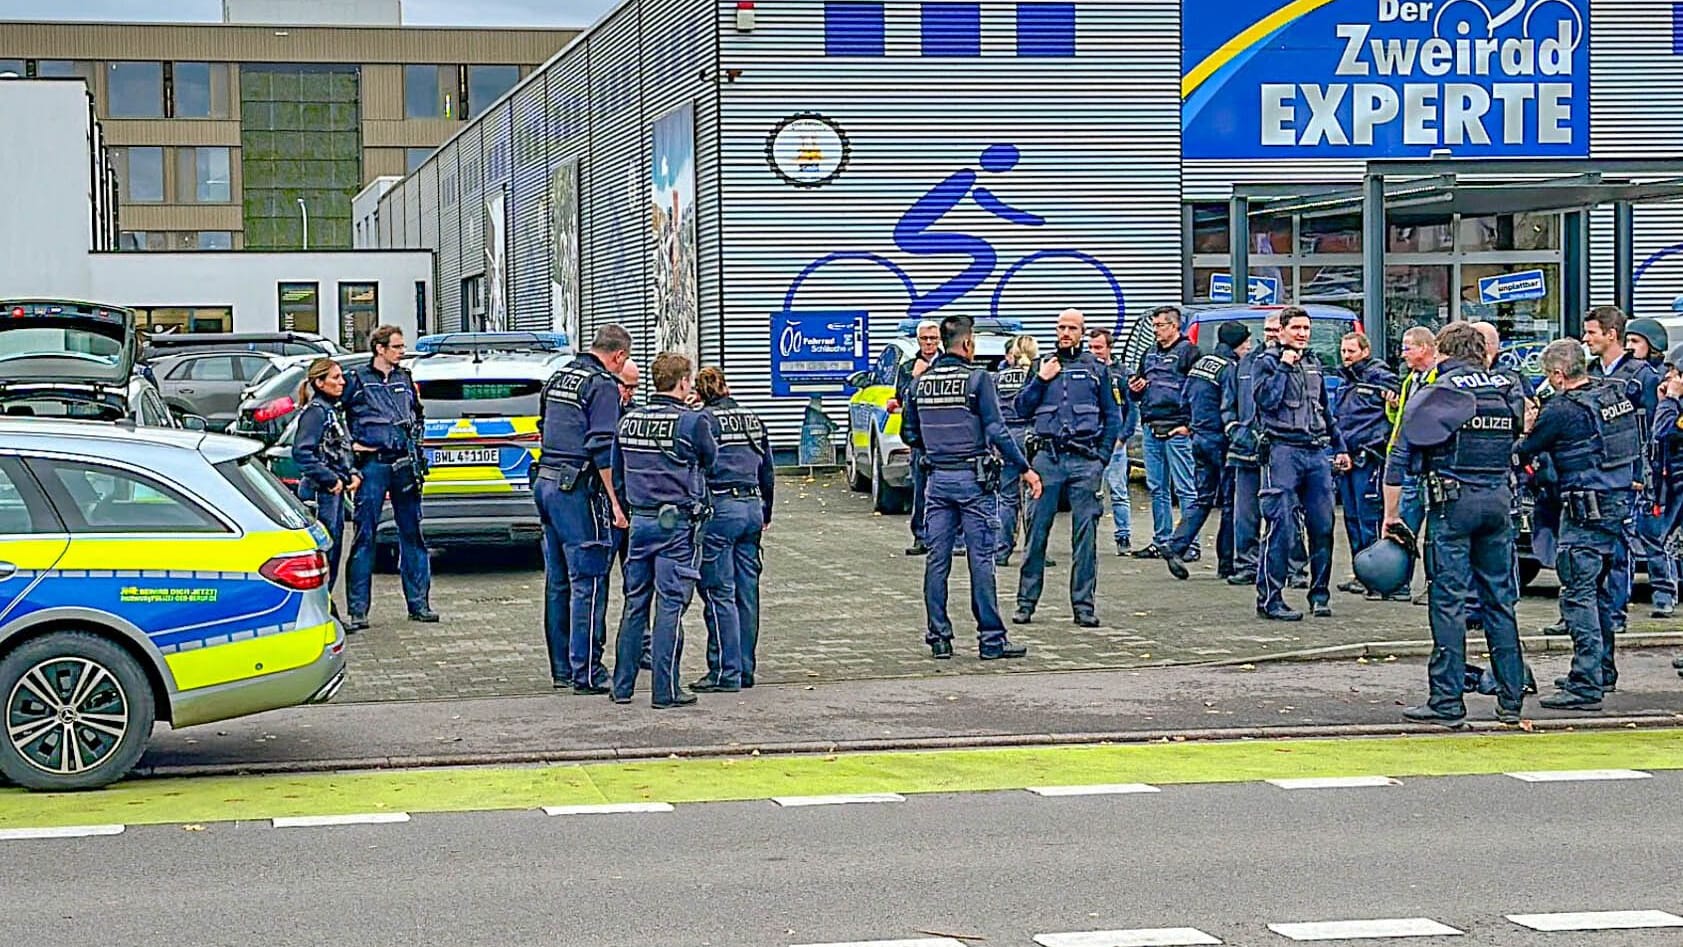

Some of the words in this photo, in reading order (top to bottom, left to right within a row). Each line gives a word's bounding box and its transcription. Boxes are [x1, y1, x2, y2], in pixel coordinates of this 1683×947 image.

[1378, 0, 1432, 21] Der
[1335, 20, 1572, 76] Zweirad
[1260, 83, 1573, 146] EXPERTE
[1498, 280, 1538, 292] unplattbar
[916, 380, 966, 396] POLIZEI
[620, 418, 674, 437] POLIZEI
[435, 450, 455, 463] BWL
[457, 450, 464, 462] 4
[471, 449, 498, 462] 110E
